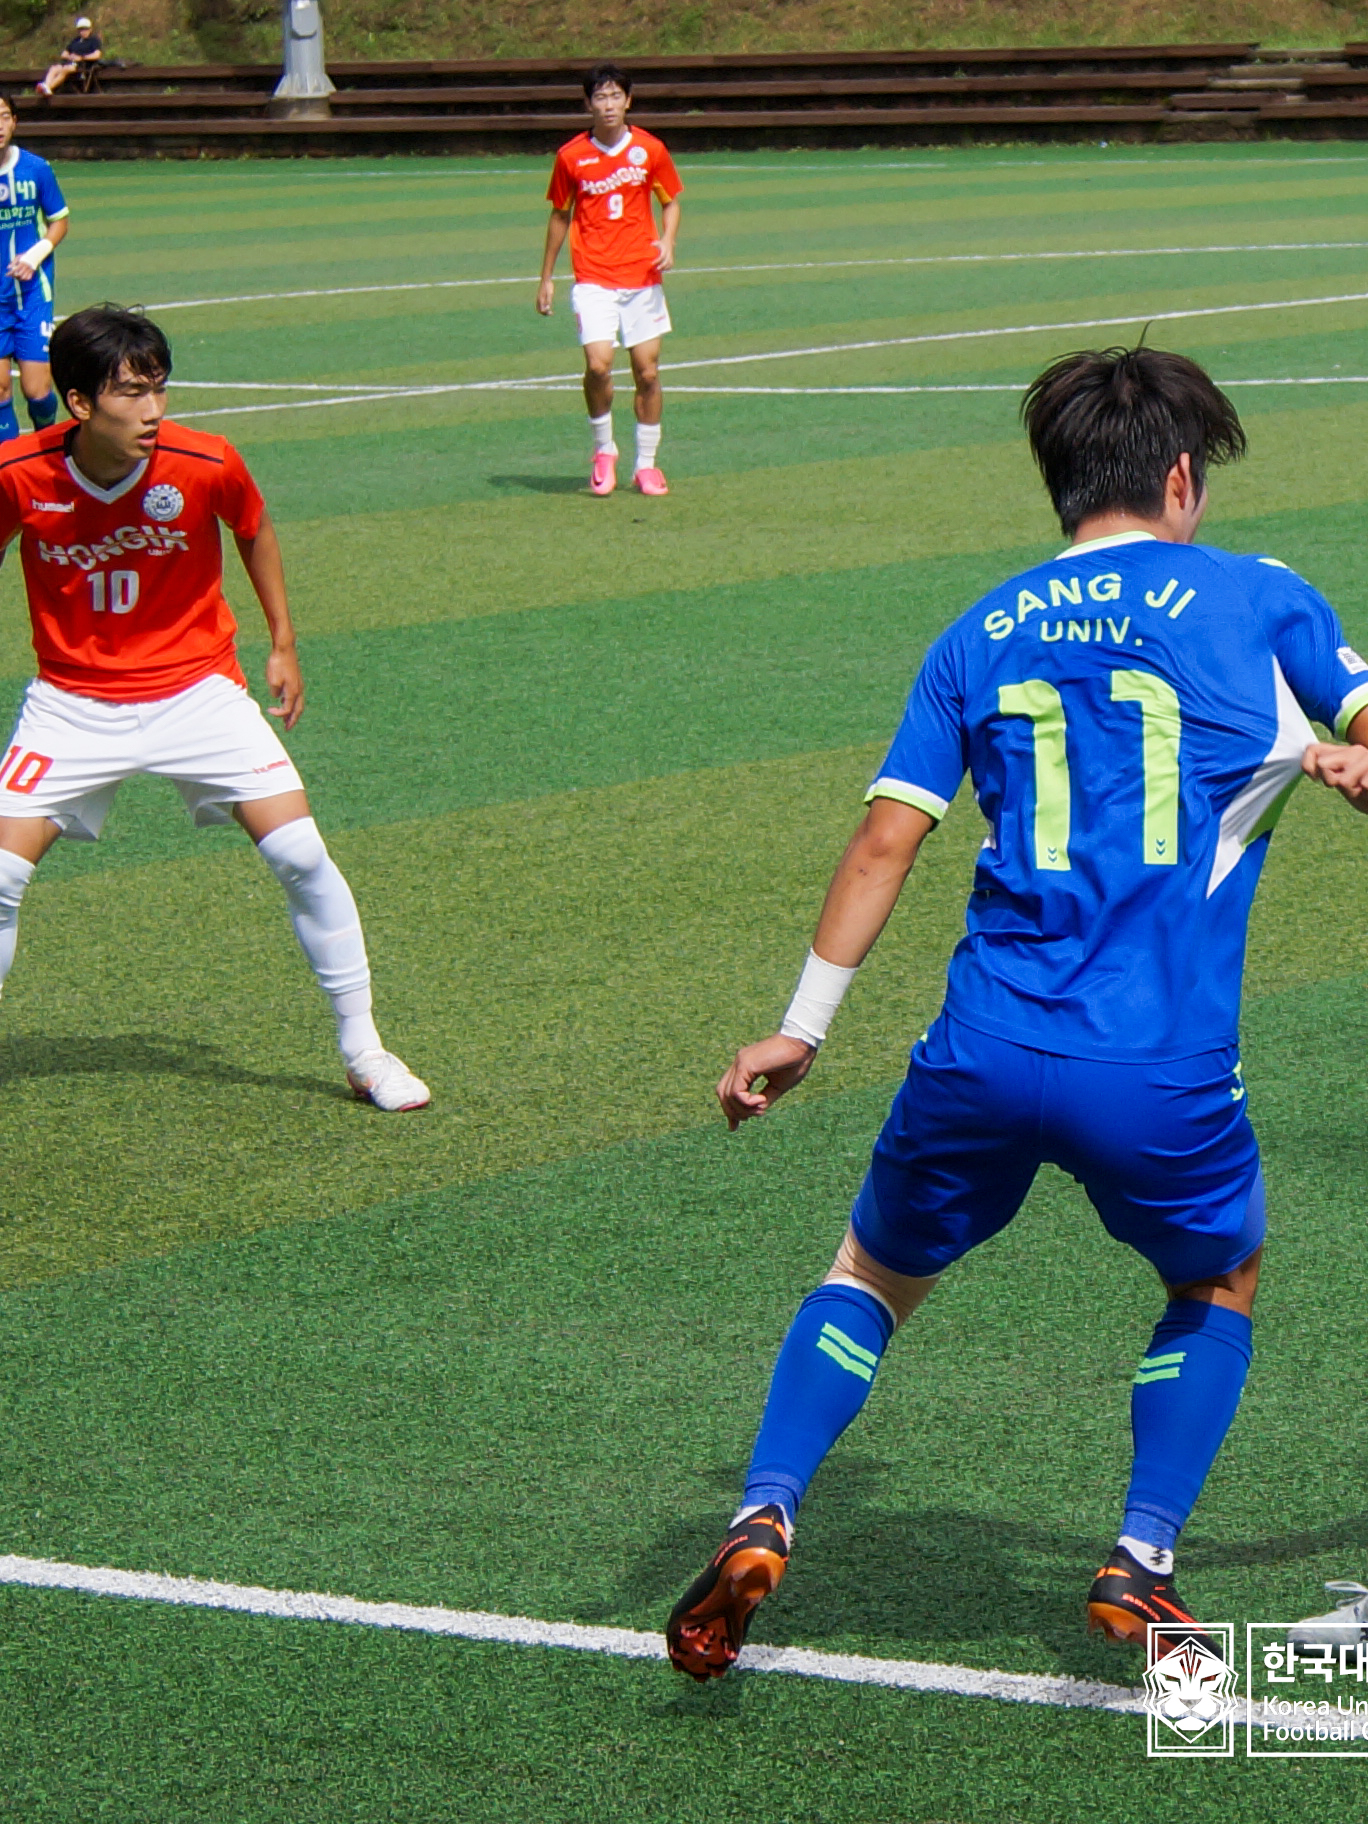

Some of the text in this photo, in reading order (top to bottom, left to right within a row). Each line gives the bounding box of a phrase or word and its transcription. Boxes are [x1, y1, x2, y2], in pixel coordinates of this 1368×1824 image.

[16, 180, 36, 200] 41
[608, 193, 624, 220] 9
[38, 525, 189, 570] HONGIK
[87, 570, 140, 614] 10
[984, 572, 1196, 640] SANG JI
[1040, 616, 1143, 646] UNIV.
[998, 669, 1181, 871] 11
